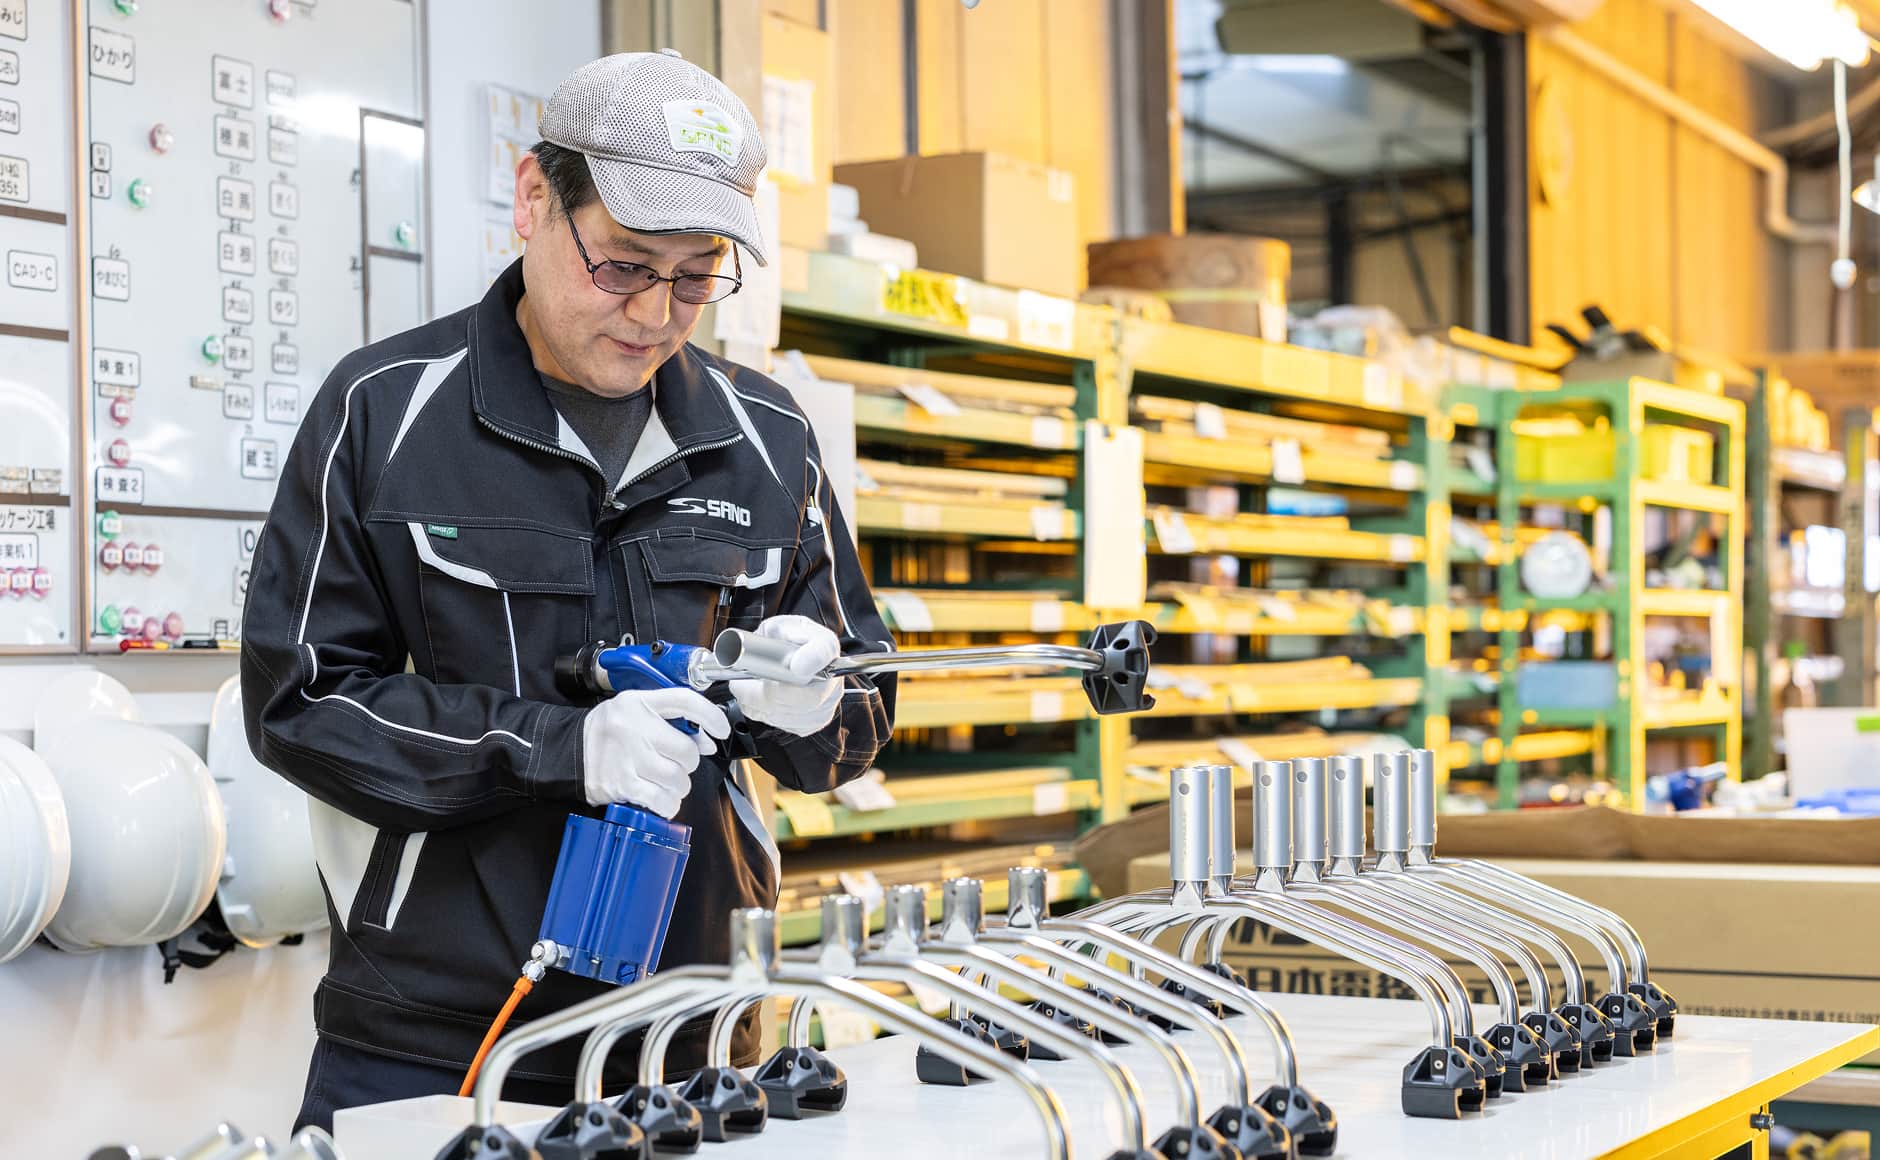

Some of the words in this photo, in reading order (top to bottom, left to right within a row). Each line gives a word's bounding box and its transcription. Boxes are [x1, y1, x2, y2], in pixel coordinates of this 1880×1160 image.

[92, 43, 133, 70] ひかり
[103, 476, 139, 494] 検査2
[706, 499, 752, 527] SANO
